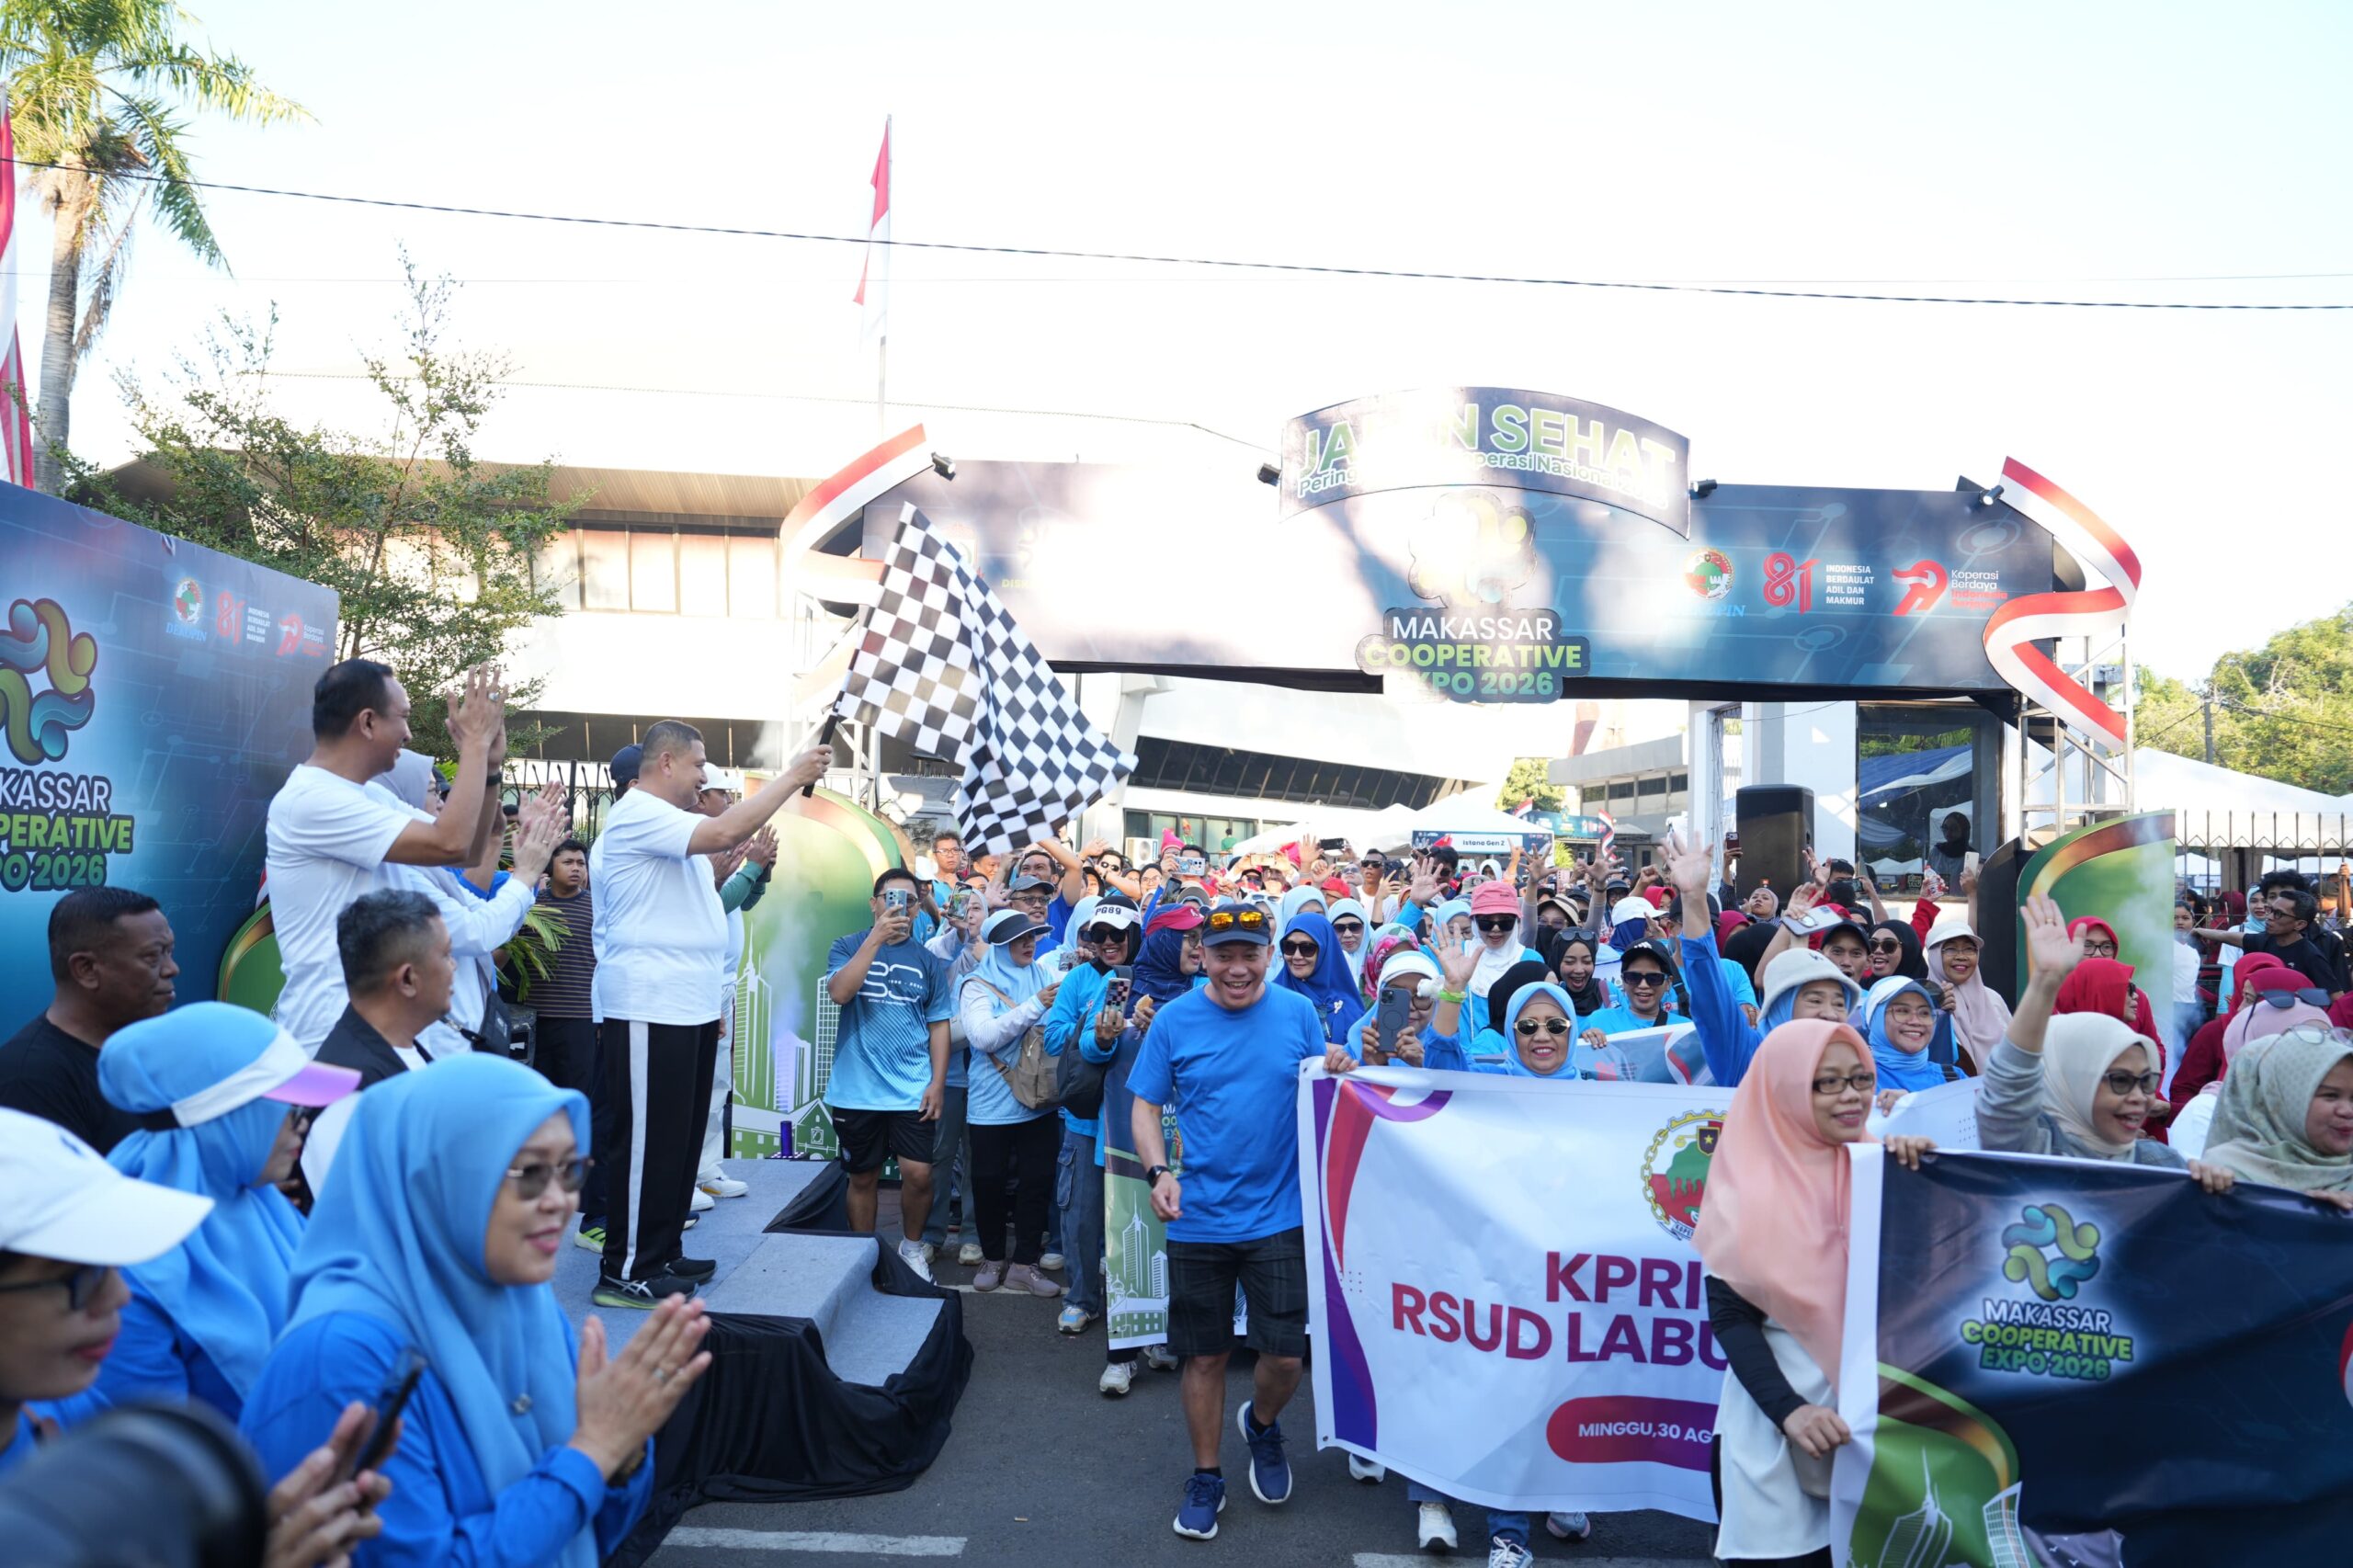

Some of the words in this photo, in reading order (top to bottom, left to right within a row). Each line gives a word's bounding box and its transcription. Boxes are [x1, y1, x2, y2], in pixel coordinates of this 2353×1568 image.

[1300, 403, 1479, 479] JAN
[1490, 403, 1676, 485] SEHAT
[1536, 452, 1618, 490] Nasional
[1825, 564, 1871, 574] INDONESIA
[1825, 574, 1875, 585] BERDAULAT
[1951, 569, 1999, 581] Koperasi
[1825, 585, 1846, 594] ADIL
[1847, 586, 1865, 595] DAN
[1951, 579, 1997, 592] Berdaya
[1825, 596, 1865, 606] MAKMUR
[1392, 616, 1553, 641] MAKASSAR
[1364, 642, 1582, 668] COOPERATIVE
[1481, 671, 1554, 696] 2026
[34, 853, 104, 887] 2026
[1546, 1250, 1702, 1311] KPRI
[1391, 1282, 1552, 1360] RSUD
[1984, 1299, 2110, 1333] MAKASSAR
[1961, 1321, 2132, 1361] COOPERATIVE
[1981, 1346, 2047, 1374] EXPO
[2050, 1354, 2110, 1380] 2026
